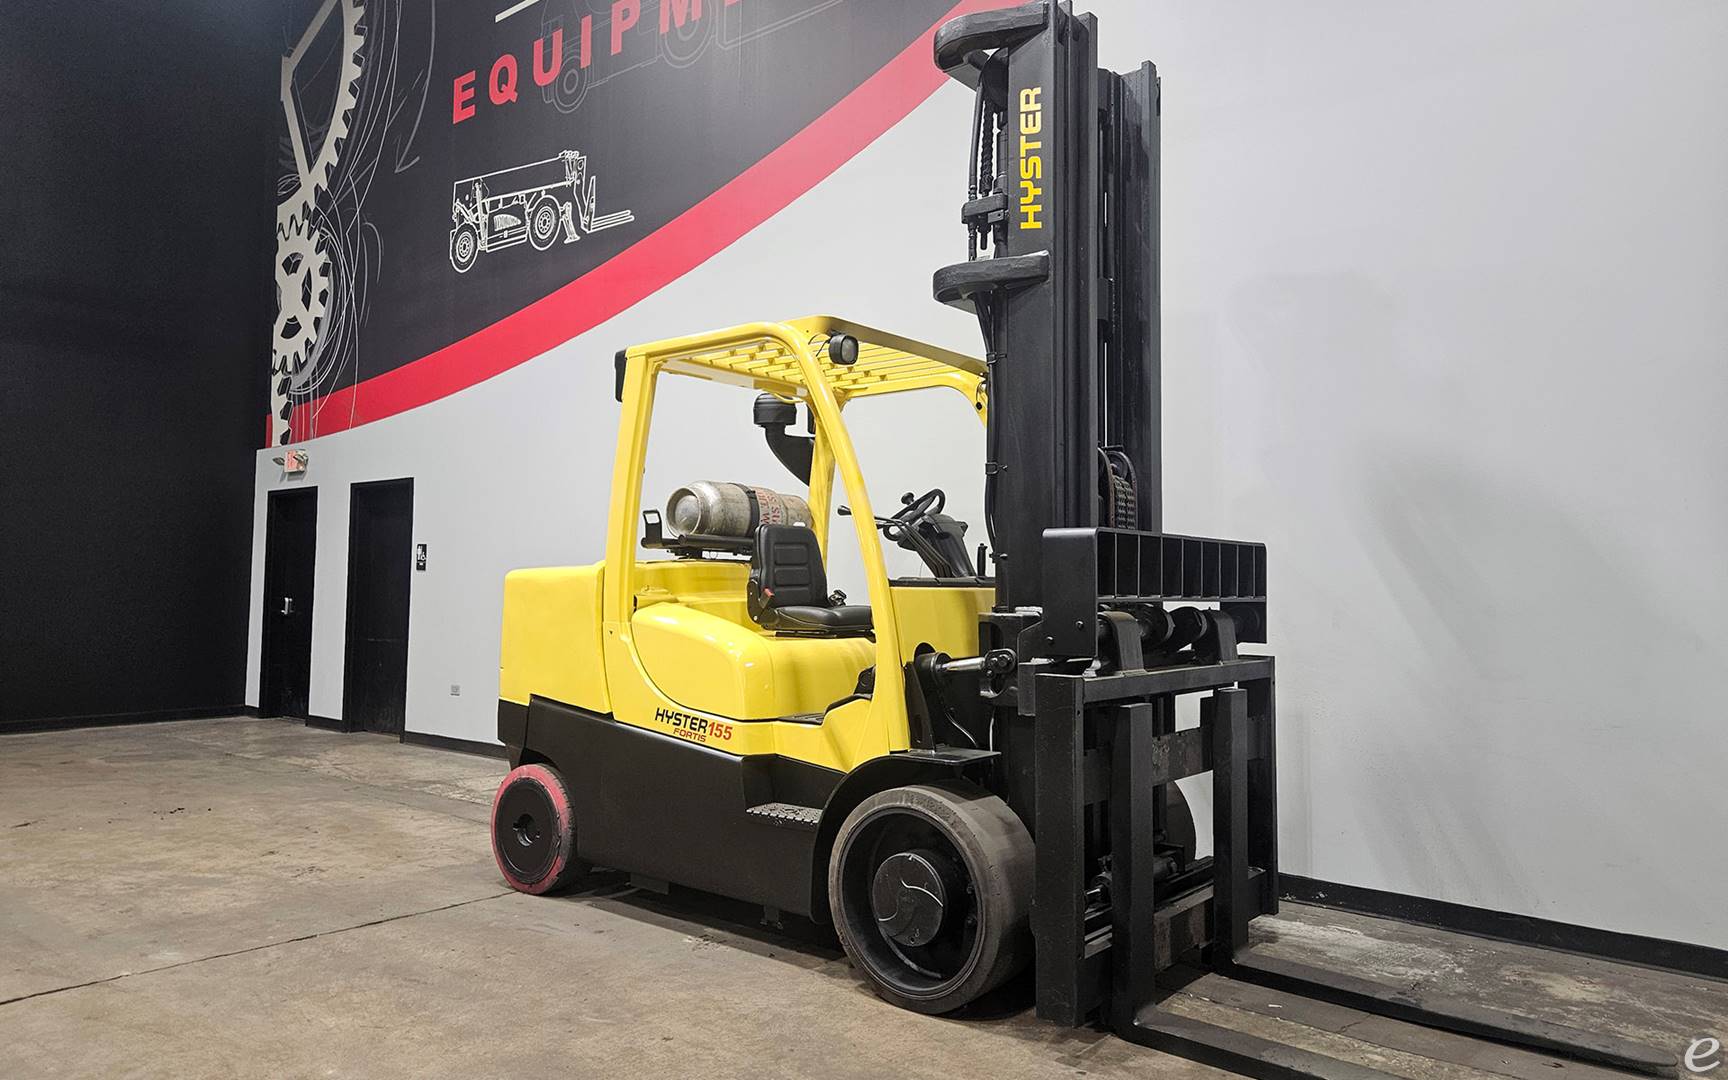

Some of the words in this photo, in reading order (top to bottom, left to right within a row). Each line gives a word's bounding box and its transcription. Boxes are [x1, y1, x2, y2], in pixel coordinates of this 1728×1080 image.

[453, 0, 740, 124] EQUIPM
[1020, 87, 1042, 229] HYSTER
[655, 707, 708, 733] HYSTER
[709, 722, 733, 740] 155
[673, 728, 707, 742] FORTIS
